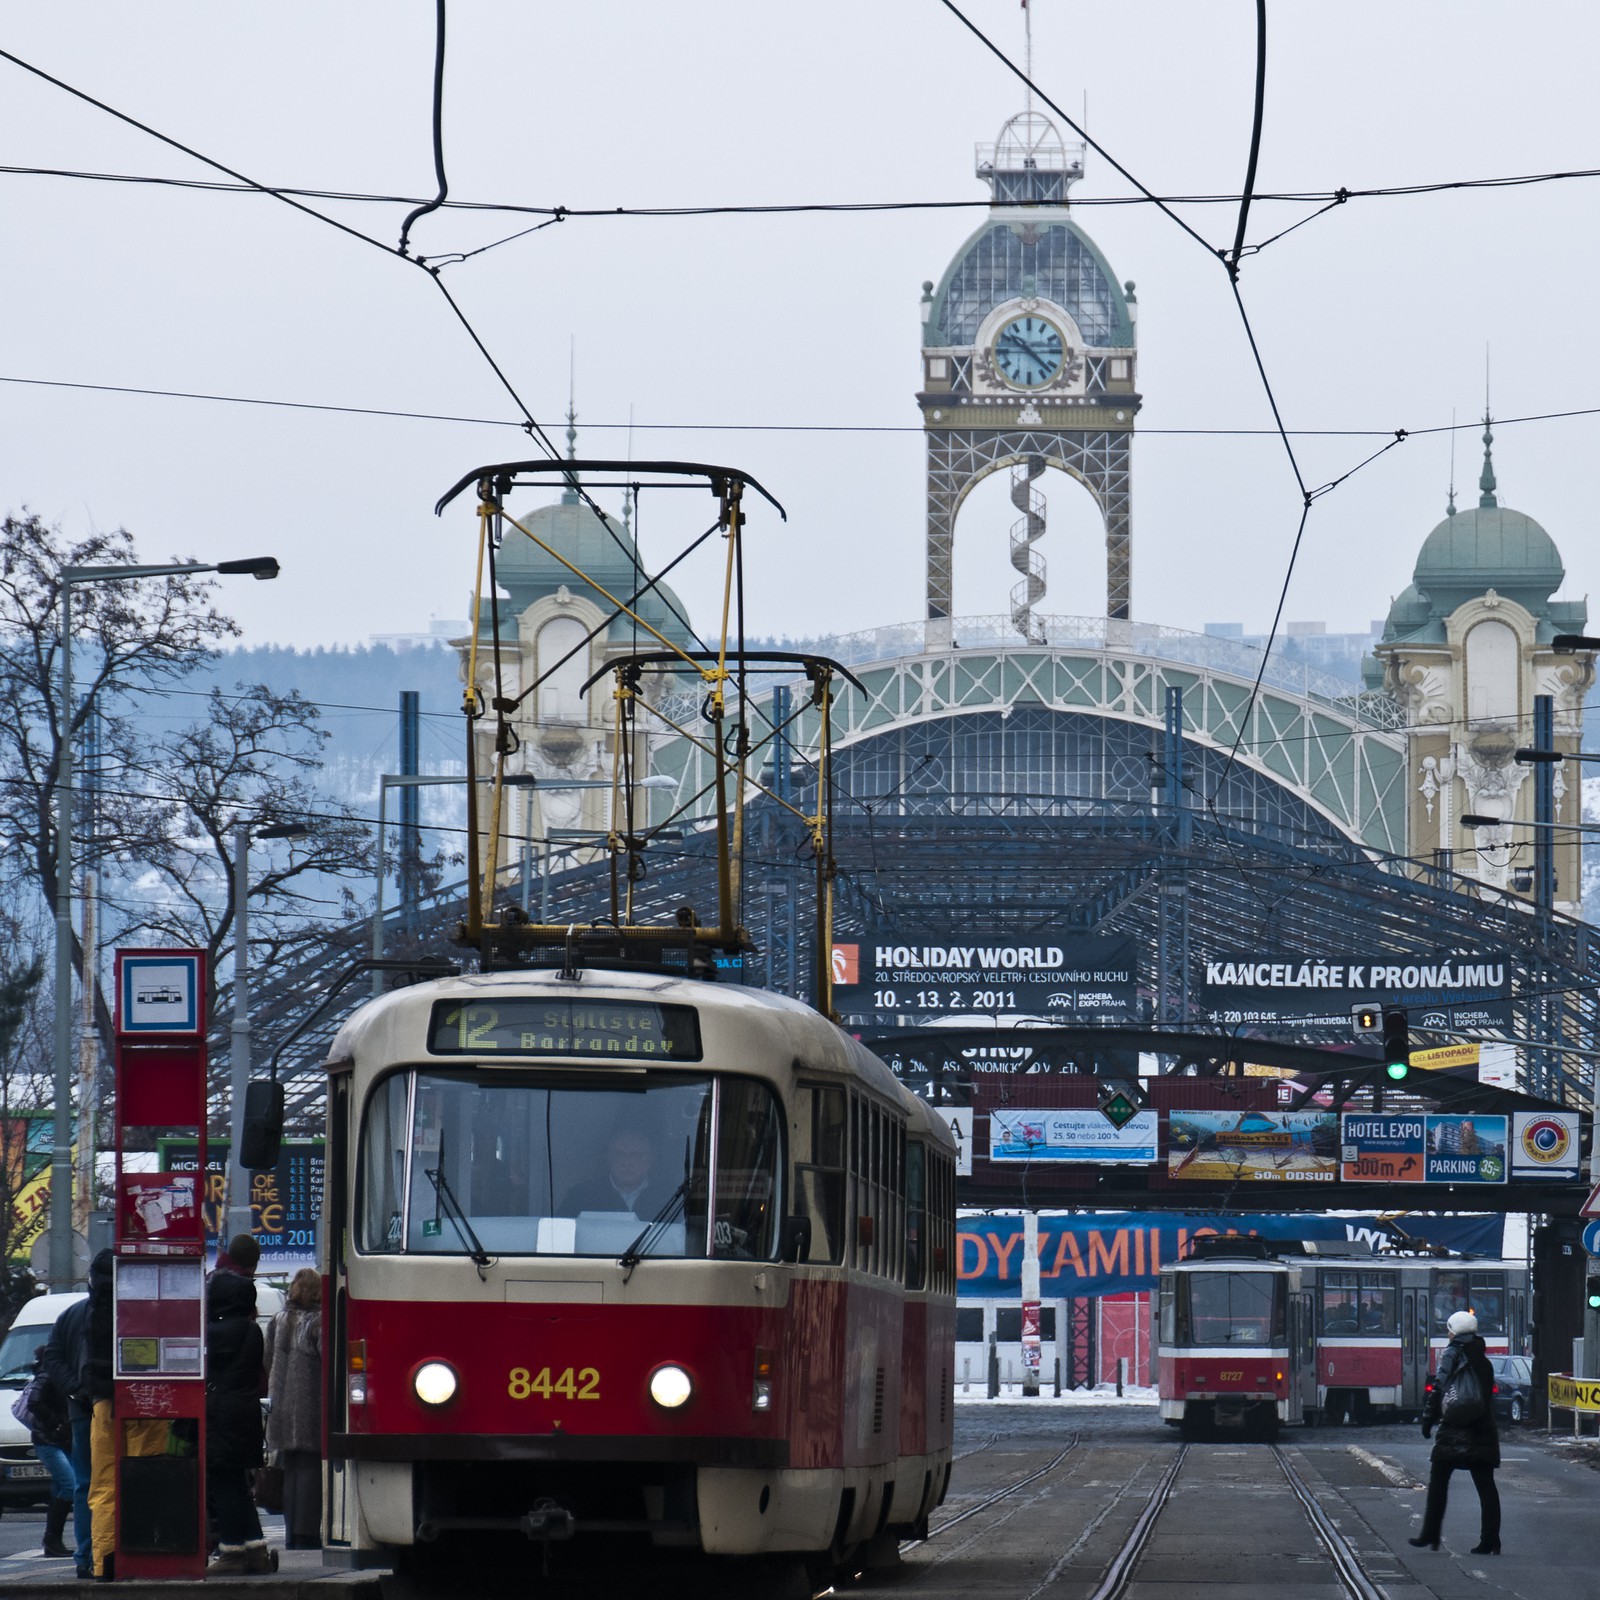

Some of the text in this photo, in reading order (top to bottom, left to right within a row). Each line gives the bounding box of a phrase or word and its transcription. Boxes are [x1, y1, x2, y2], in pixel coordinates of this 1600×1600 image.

[875, 946, 1064, 969] HOLIDAY WORLD
[875, 971, 890, 983] 20.
[1028, 969, 1091, 983] CESTOVNÍHO
[1093, 971, 1129, 983] RUCHU
[1206, 958, 1505, 989] KANCELÁŘE K PRONÁJMU
[874, 990, 901, 1008] 10.
[916, 990, 944, 1008] 13.
[949, 990, 966, 1008] 2.
[972, 990, 1016, 1008] 2011
[1078, 993, 1113, 1001] INCHEBA
[1078, 1000, 1127, 1008] EXPO PRAHA
[1224, 1011, 1242, 1023] 220
[1453, 1011, 1490, 1020] INCHEBA
[446, 1007, 499, 1049] 12
[1454, 1018, 1505, 1027] EXPO PRAHA
[520, 1032, 673, 1053] Barrandov
[1427, 1046, 1474, 1060] LISTOPADU
[1053, 1121, 1086, 1131] Cestujte
[1348, 1122, 1422, 1139] HOTEL EXPO
[1066, 1132, 1076, 1140] 50
[1077, 1132, 1096, 1140] nebo
[1097, 1132, 1111, 1140] 100
[170, 1161, 223, 1171] MICHEL
[310, 1158, 326, 1166] Brn
[1430, 1160, 1476, 1173] PARKING
[310, 1167, 325, 1175] Par
[1285, 1171, 1334, 1181] ODSUD
[253, 1174, 277, 1188] OF
[310, 1185, 325, 1193] Pra
[287, 1229, 316, 1246] 201
[1239, 1327, 1254, 1340] 12
[1220, 1371, 1243, 1381] 8727
[507, 1366, 600, 1400] 8442
